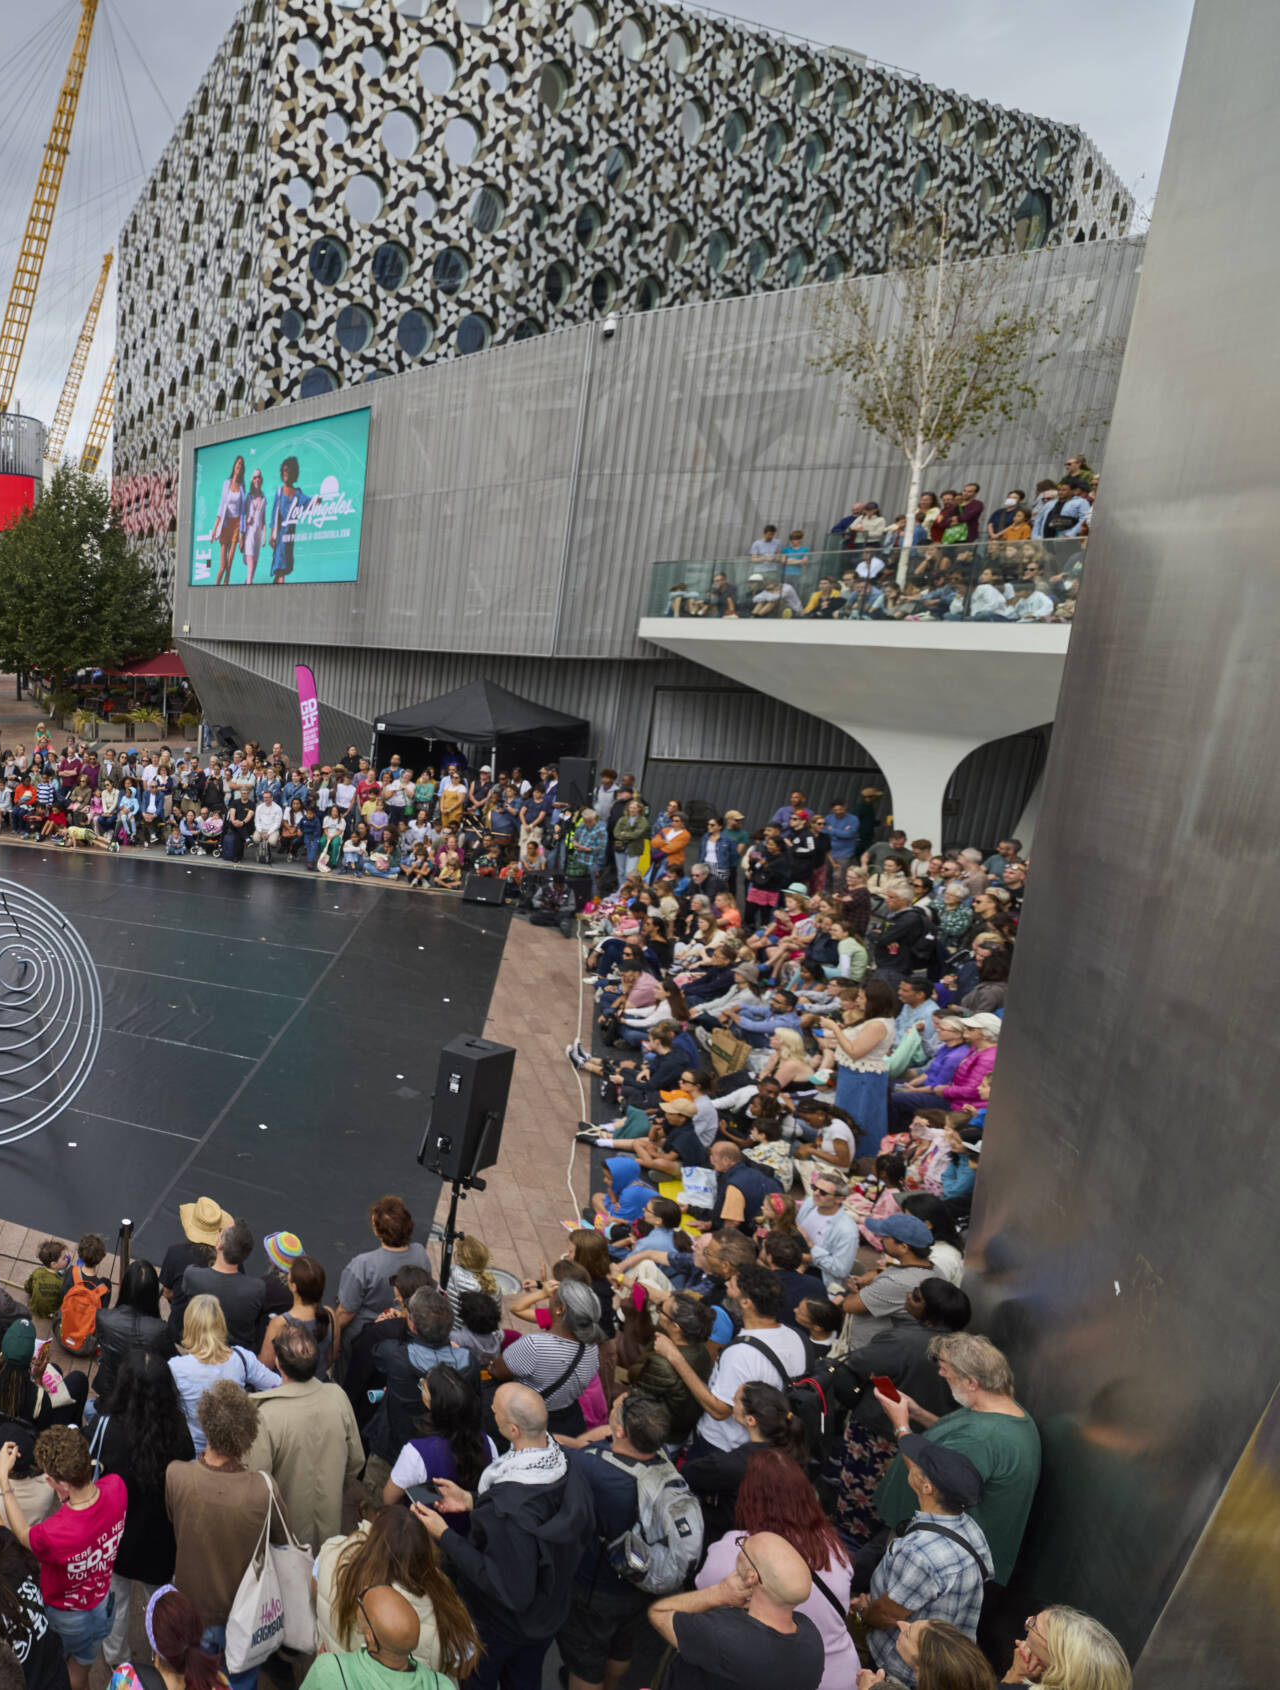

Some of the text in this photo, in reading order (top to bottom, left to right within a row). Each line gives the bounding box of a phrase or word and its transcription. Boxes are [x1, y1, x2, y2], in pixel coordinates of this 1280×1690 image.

[281, 492, 355, 528] Los Angeles
[300, 698, 318, 715] GD
[301, 711, 319, 730] IF
[97, 1532, 108, 1546] TO
